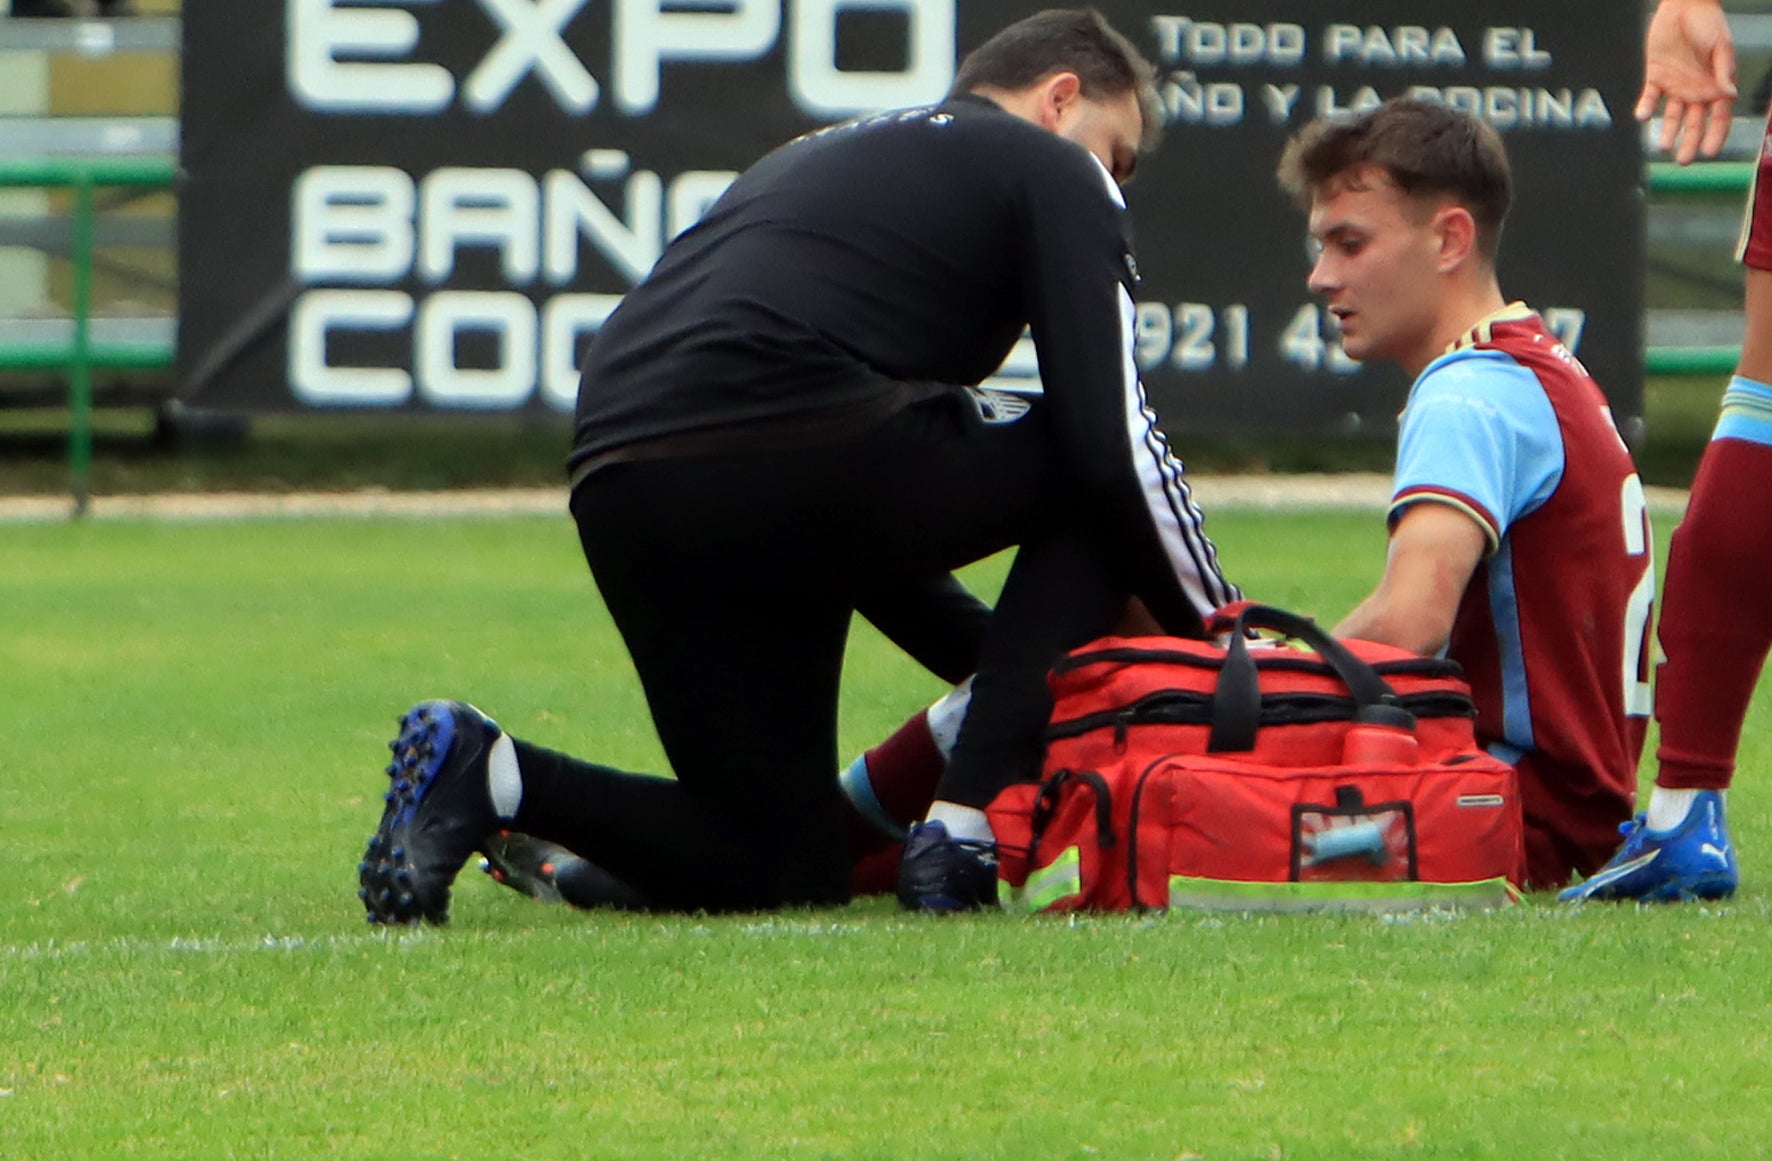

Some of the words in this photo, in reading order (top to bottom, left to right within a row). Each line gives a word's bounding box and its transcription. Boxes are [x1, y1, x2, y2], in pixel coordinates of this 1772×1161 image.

[1151, 13, 1306, 68] TODO
[1323, 23, 1467, 67] PARA
[1483, 25, 1553, 69] EL
[1158, 69, 1243, 126] ÑO
[1260, 81, 1300, 122] Y
[1136, 300, 1249, 373] 921
